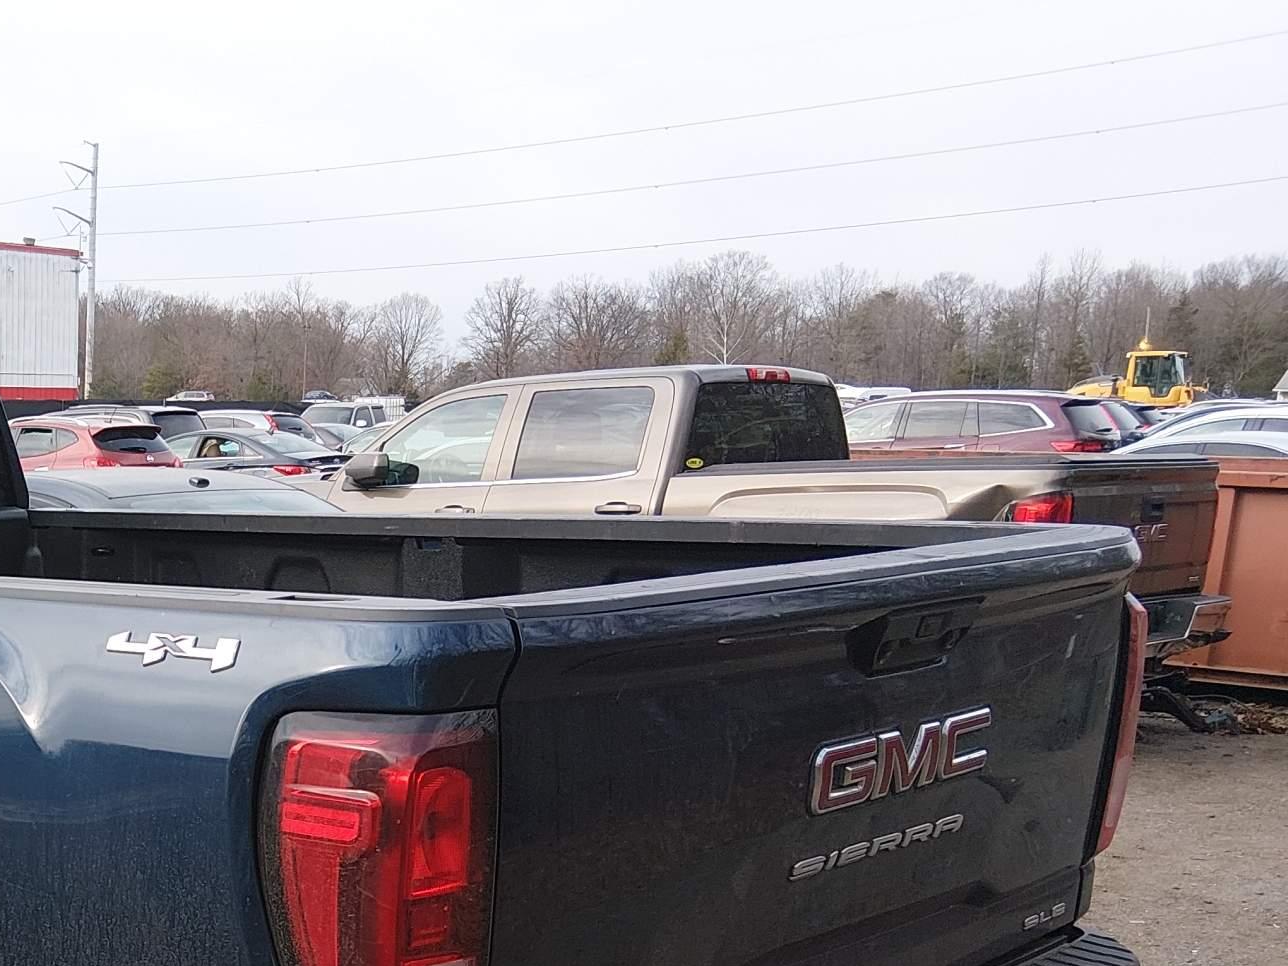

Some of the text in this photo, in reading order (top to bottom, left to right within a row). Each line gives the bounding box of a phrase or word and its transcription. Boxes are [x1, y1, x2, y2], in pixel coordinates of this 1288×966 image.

[809, 704, 992, 816] GMC
[788, 813, 964, 881] SIERRA
[1023, 902, 1065, 930] SLE
